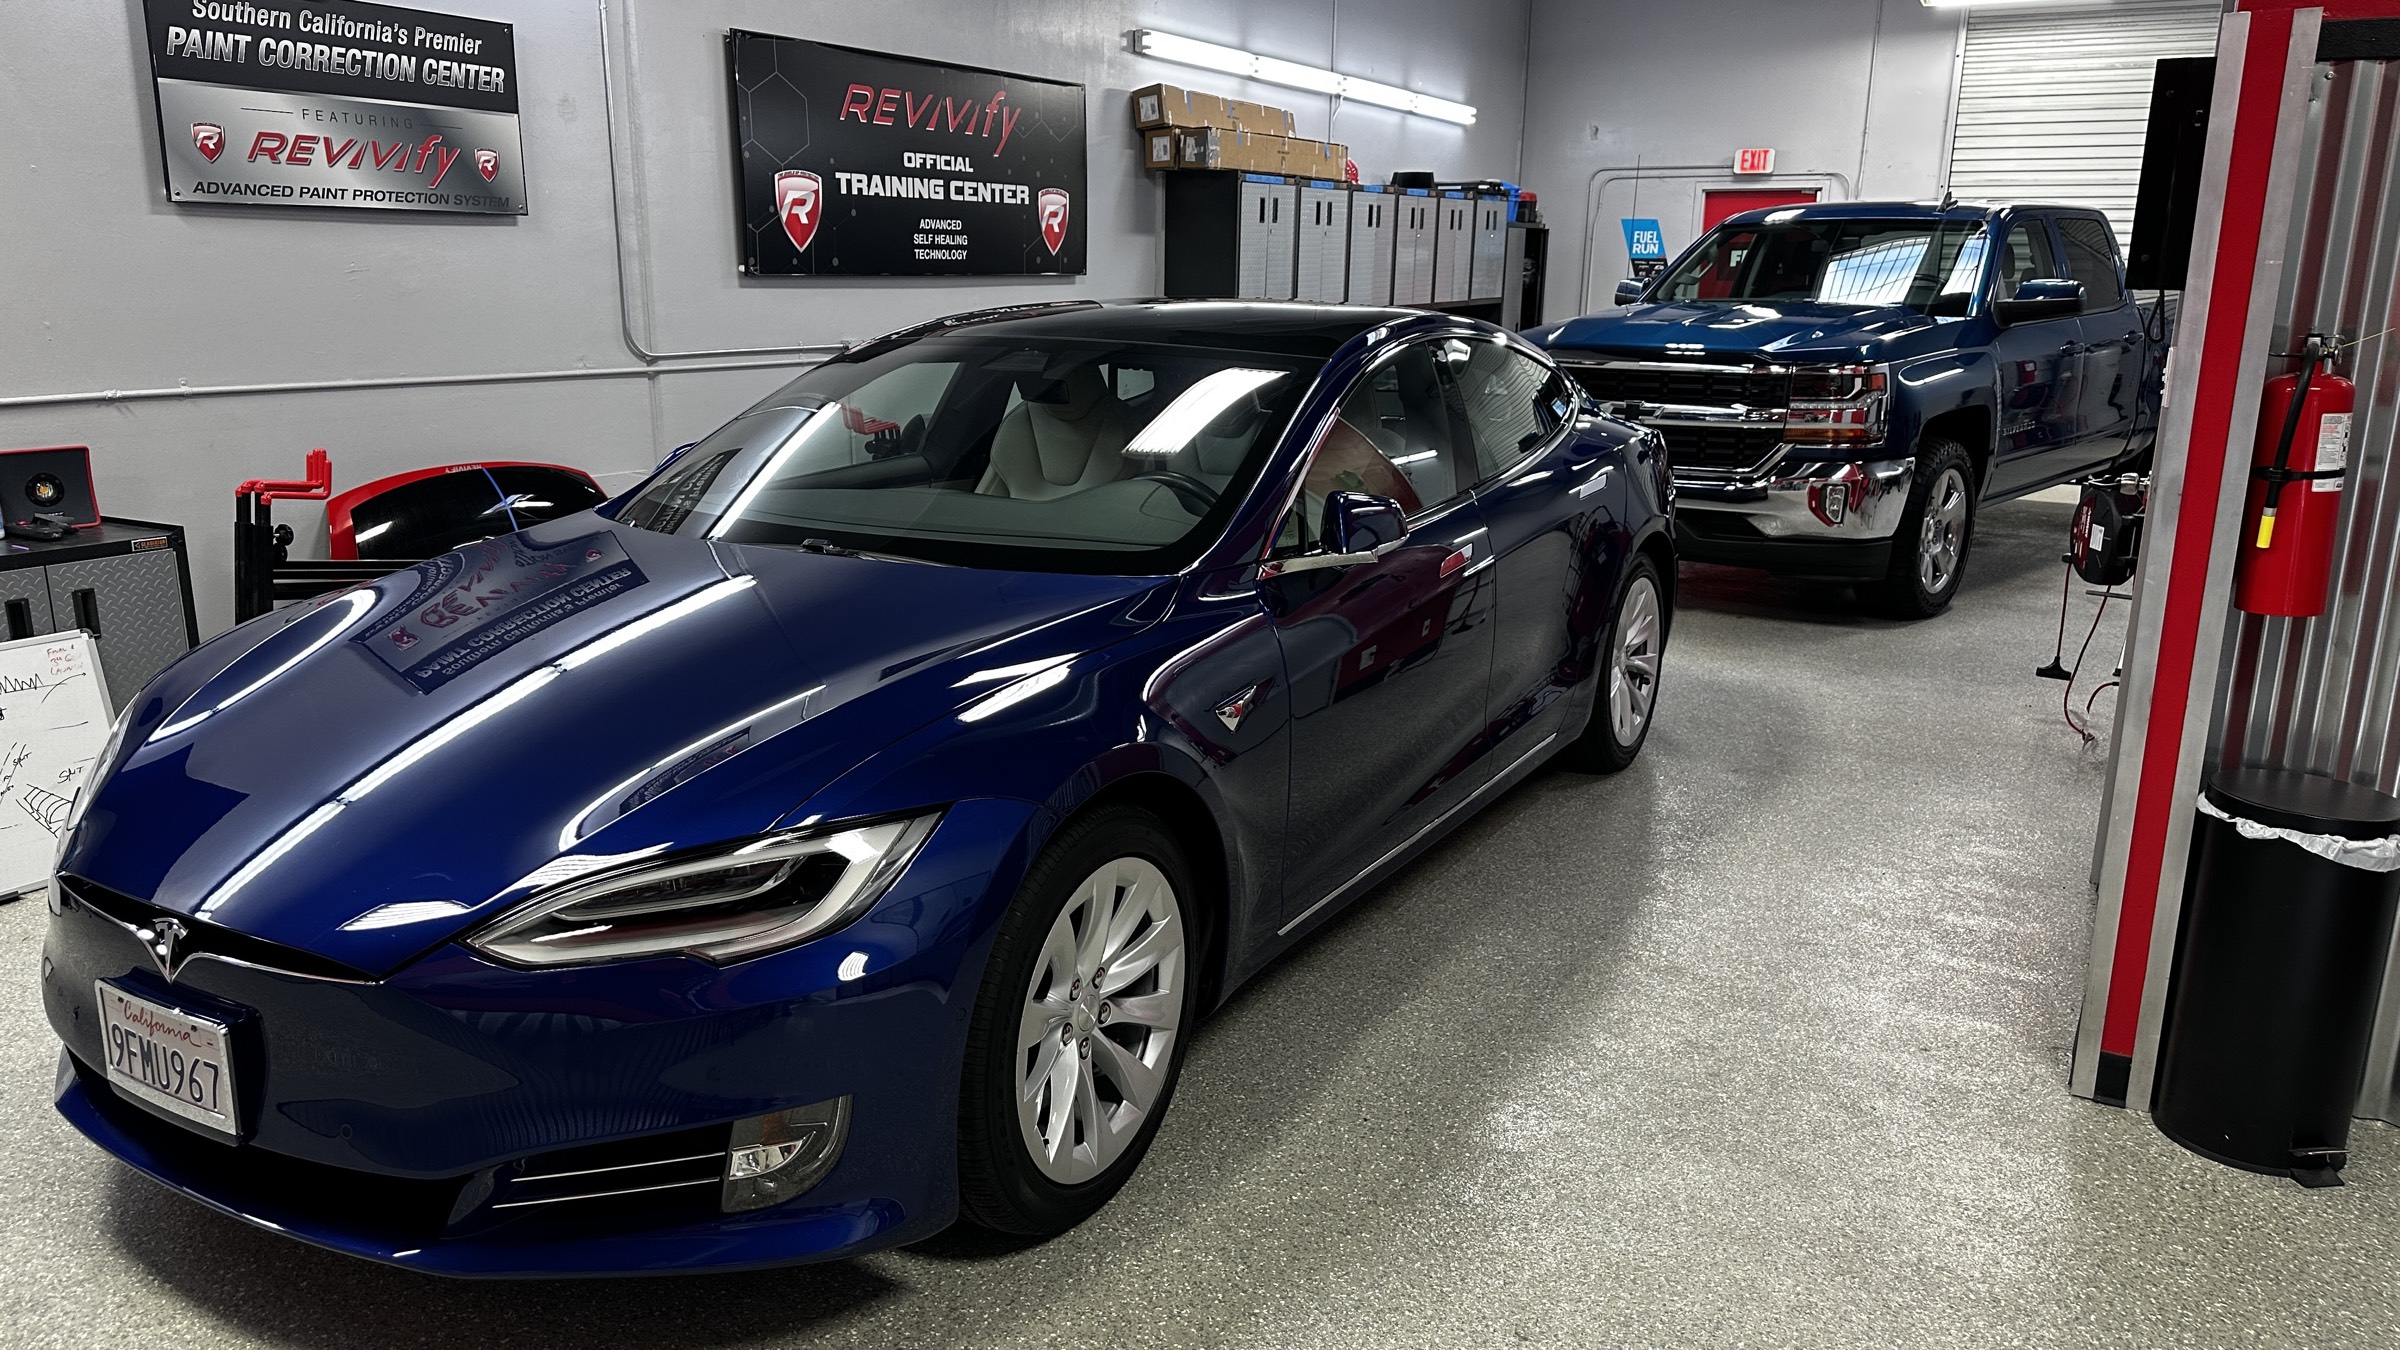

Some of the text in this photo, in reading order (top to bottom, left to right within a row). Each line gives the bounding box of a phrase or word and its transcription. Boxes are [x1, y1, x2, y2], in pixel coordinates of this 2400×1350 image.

[192, 0, 482, 55] Southern California's Premier
[166, 26, 505, 94] PAINT CORRECTION CENTER
[302, 108, 413, 129] FEATURING
[903, 151, 974, 173] OFFICIAL
[1740, 149, 1770, 172] EXIT
[192, 181, 510, 208] ADVANCED PAINT PROTECTION SYSTEM
[835, 171, 1030, 206] TRAINING CENTER
[919, 218, 962, 231] ADVANCED
[913, 233, 968, 246] SELF HEALING
[1633, 230, 1659, 243] FUEL
[914, 248, 968, 261] TECHNOLOGY
[1632, 243, 1659, 255] RUN
[123, 1000, 202, 1047] California
[111, 1023, 219, 1111] 9FMU967
